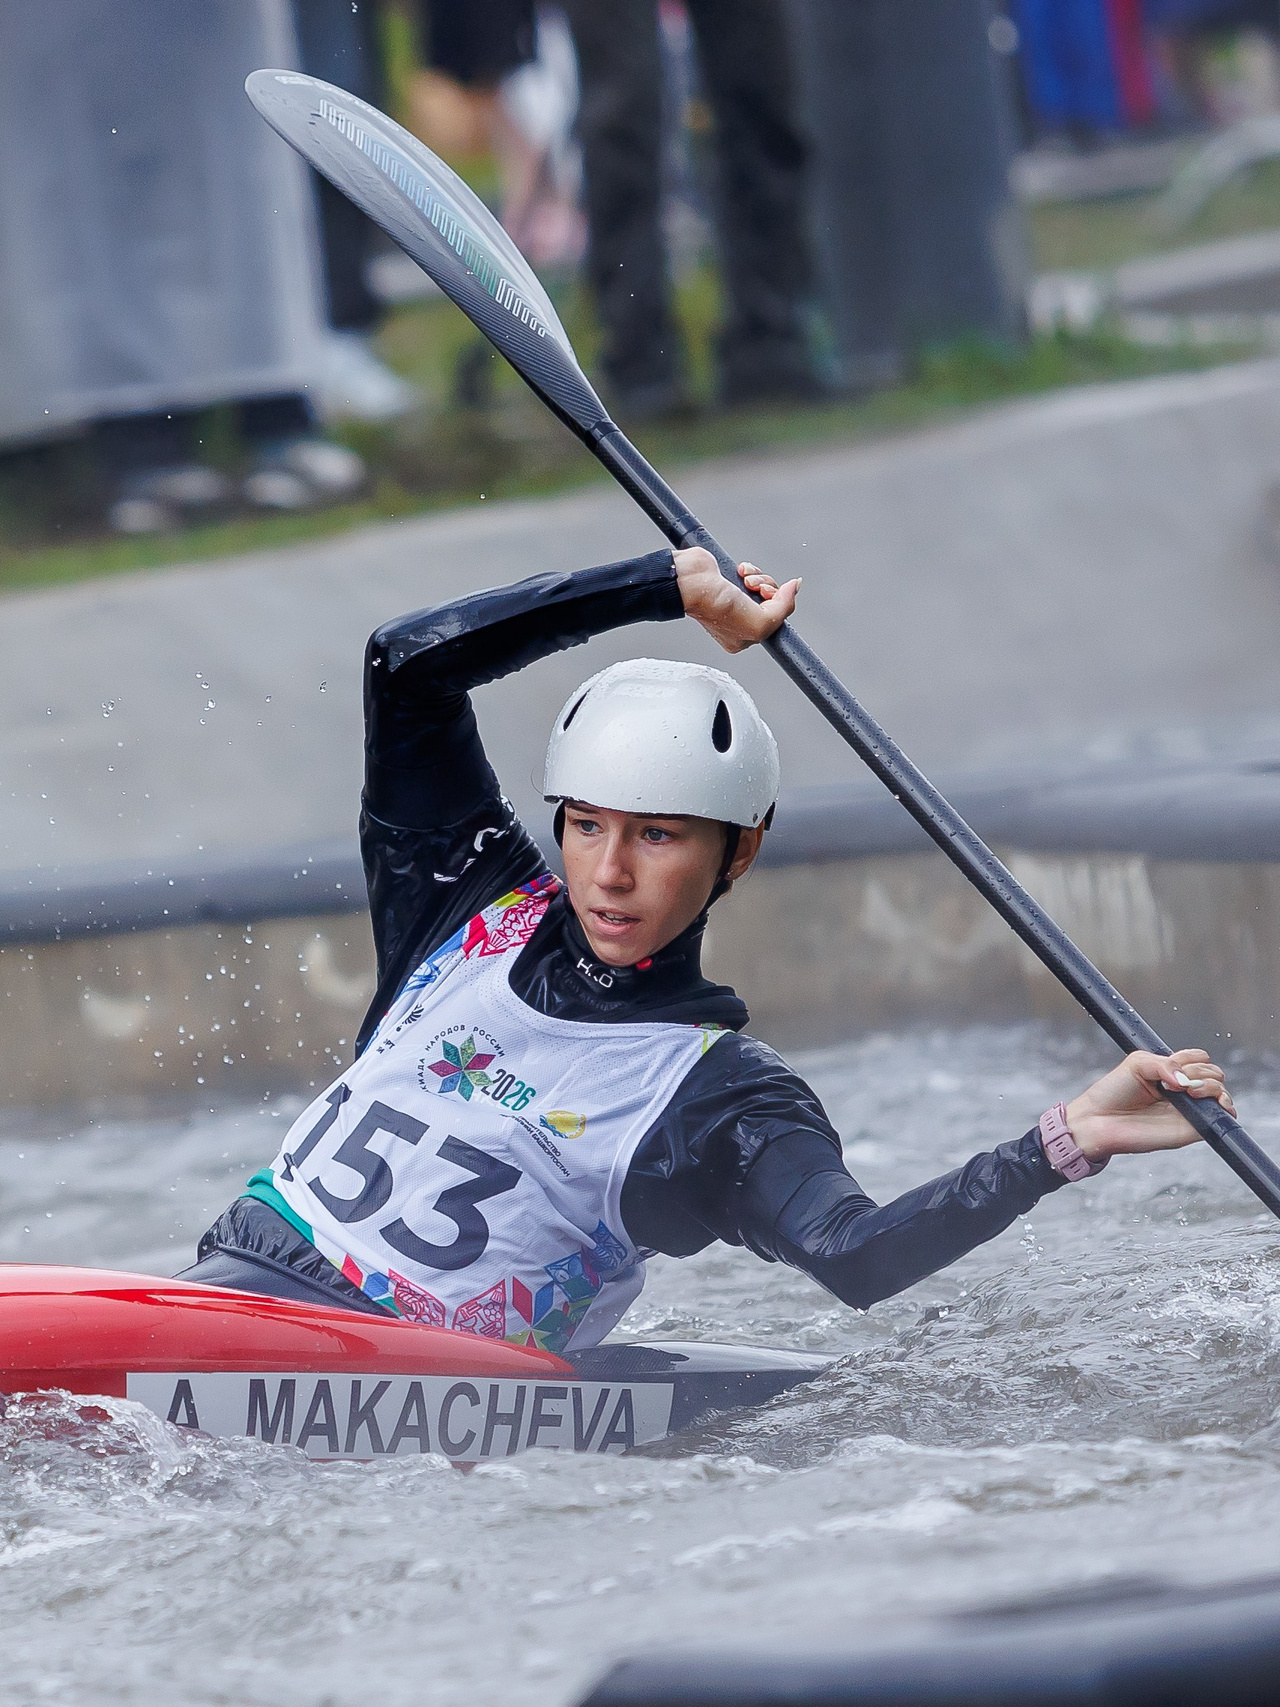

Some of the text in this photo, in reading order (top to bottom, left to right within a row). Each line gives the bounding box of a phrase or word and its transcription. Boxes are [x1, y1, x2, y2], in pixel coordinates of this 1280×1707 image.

[424, 1023, 466, 1052] НАРОДОВ
[472, 1026, 506, 1058] РОССИИ
[480, 1068, 537, 1112] 2026
[280, 1081, 522, 1271] 153
[245, 1378, 636, 1457] MAKACHEVA
